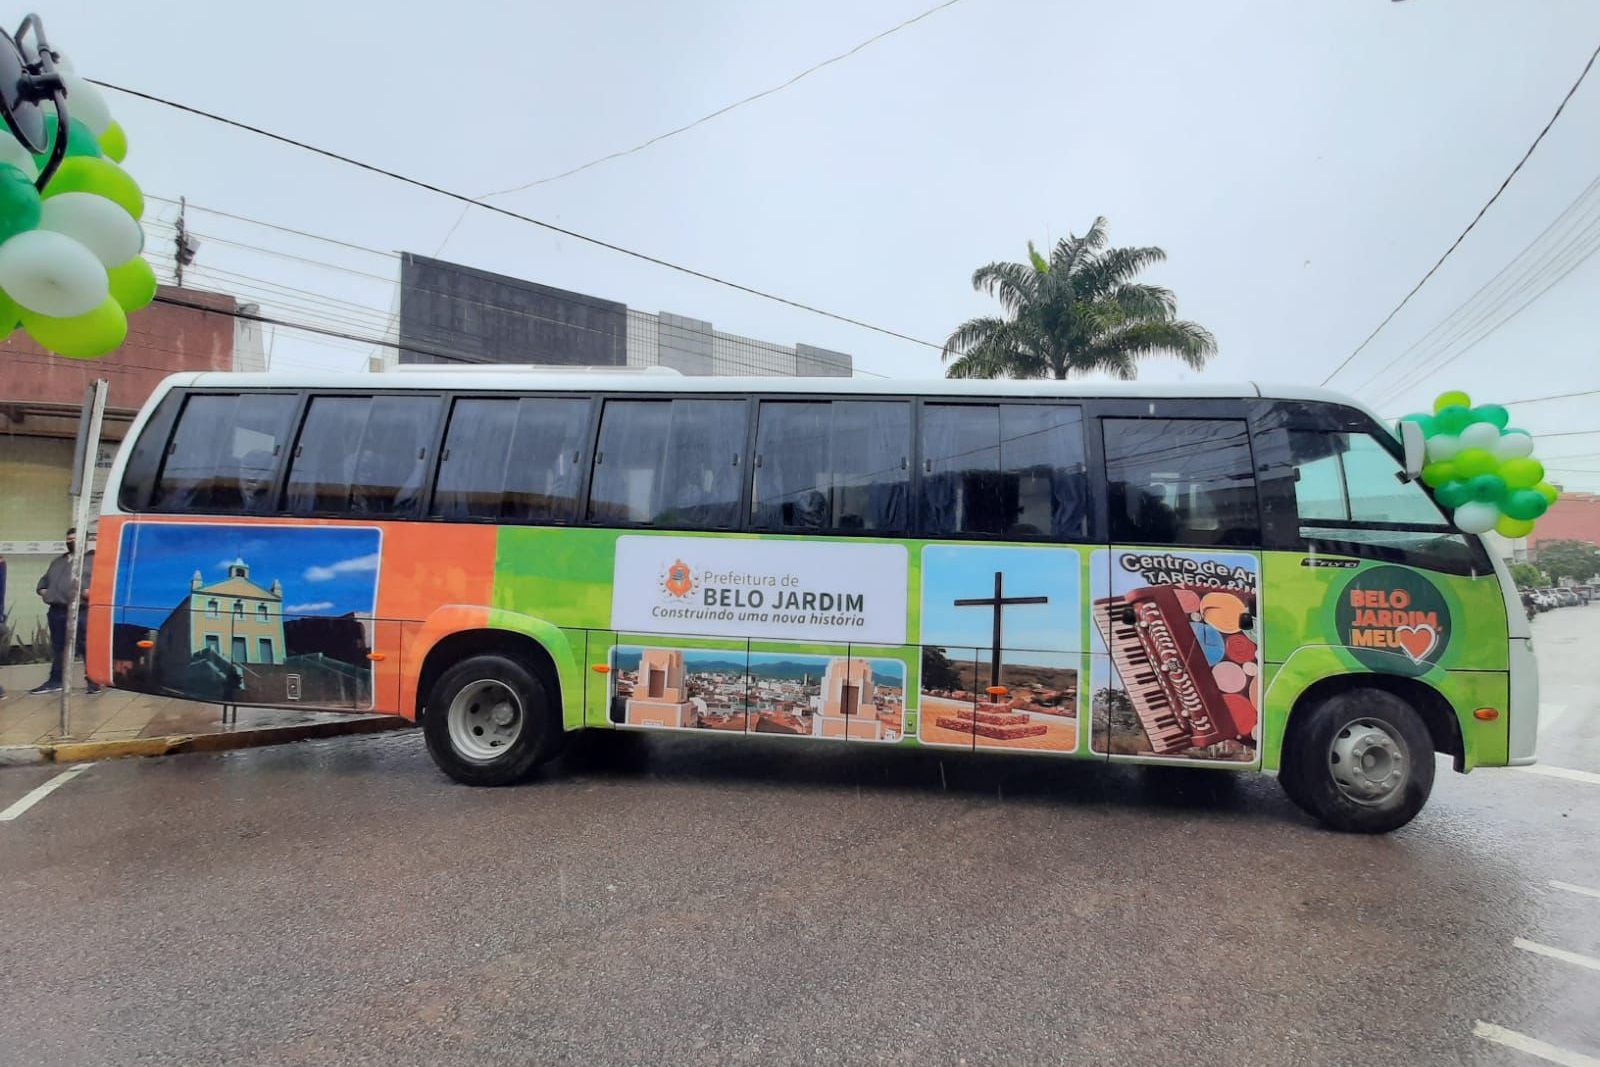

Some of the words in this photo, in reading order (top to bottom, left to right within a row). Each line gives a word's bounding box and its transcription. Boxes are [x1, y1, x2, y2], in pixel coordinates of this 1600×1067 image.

[1121, 553, 1197, 572] Centro
[1202, 561, 1229, 577] de
[703, 571, 776, 587] Prefeitura
[781, 574, 799, 587] de
[1143, 571, 1221, 590] TARECO
[703, 588, 765, 608] BELO
[771, 591, 864, 612] JARDIM
[1350, 588, 1410, 609] BELO
[651, 606, 735, 622] Construindo
[738, 612, 768, 622] uma
[772, 612, 805, 625] nova
[809, 612, 865, 627] história
[1351, 608, 1437, 630] JARDIM
[1351, 628, 1401, 648] MEU
